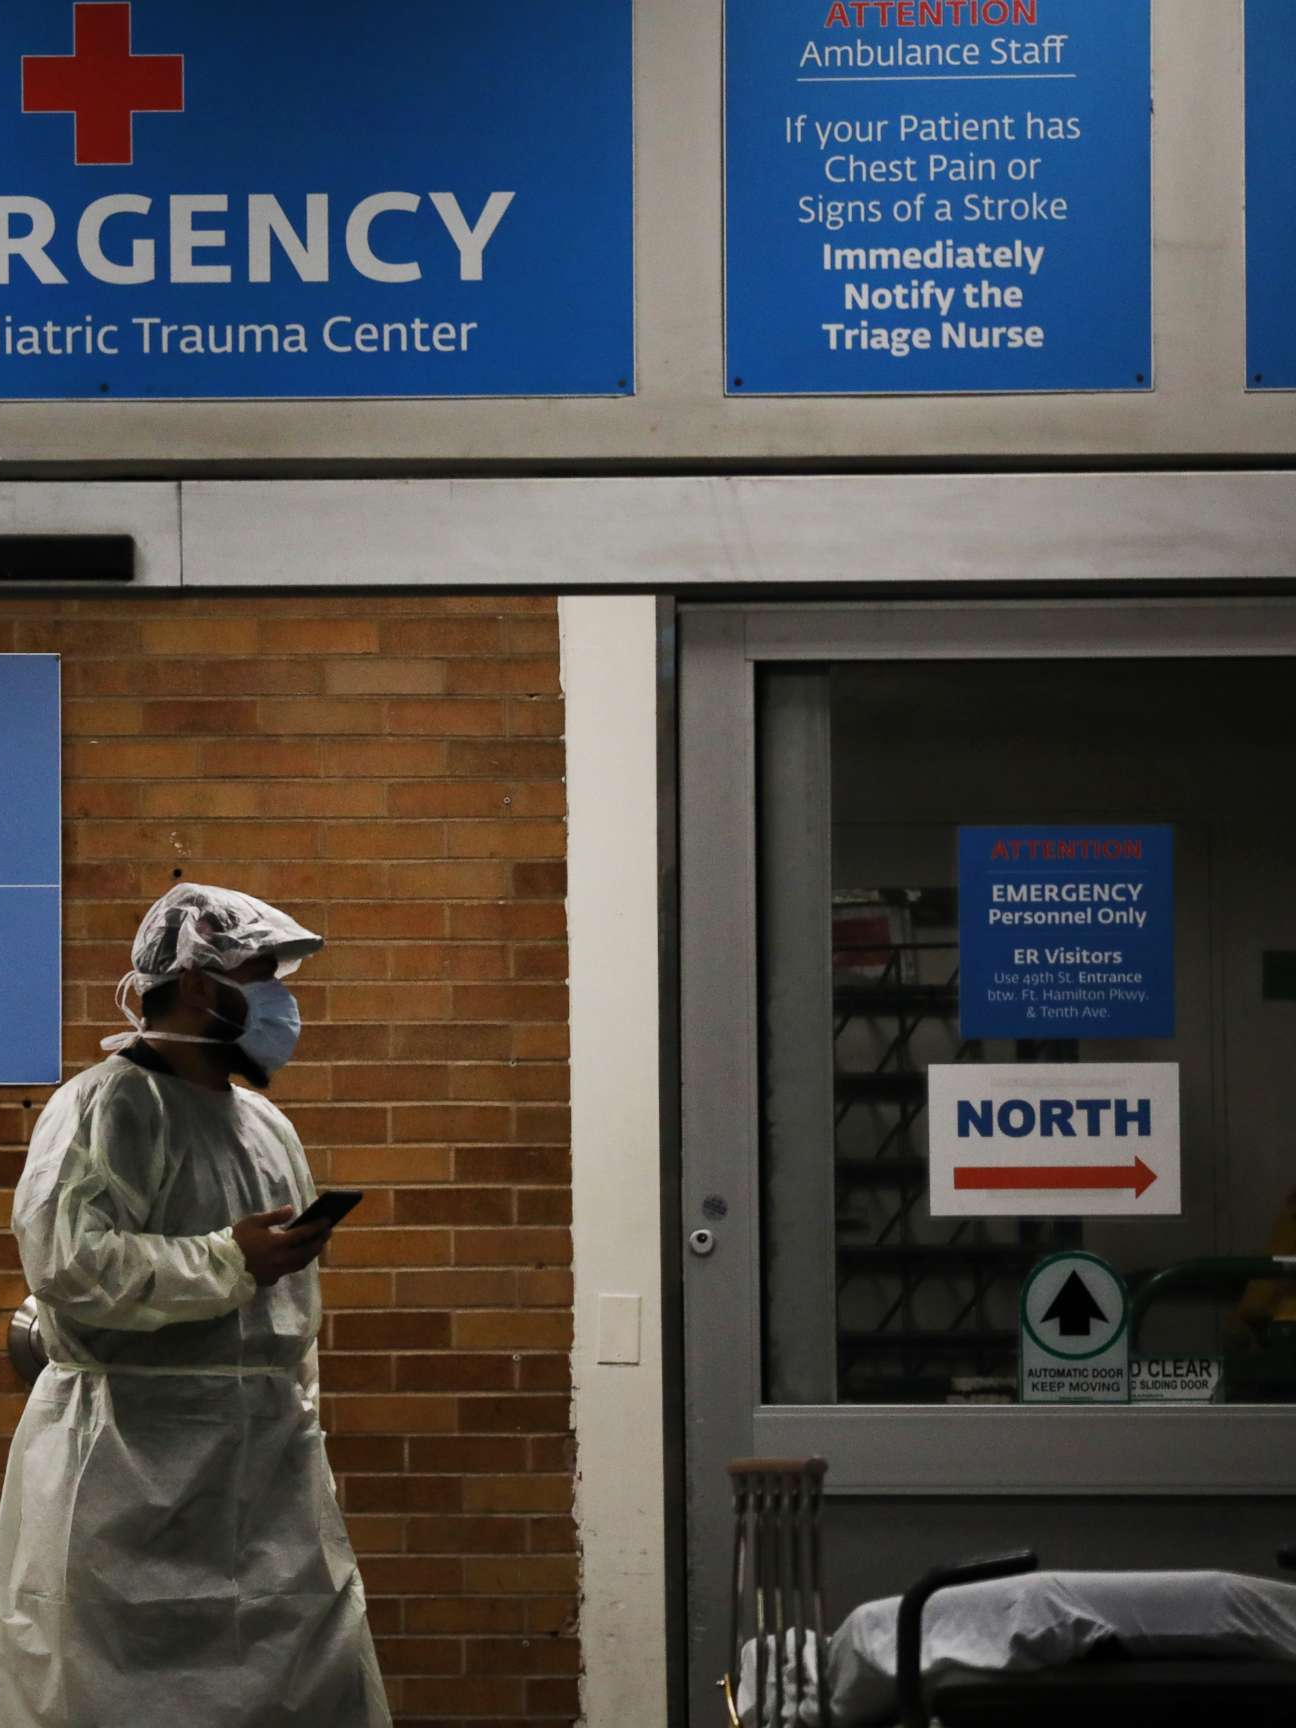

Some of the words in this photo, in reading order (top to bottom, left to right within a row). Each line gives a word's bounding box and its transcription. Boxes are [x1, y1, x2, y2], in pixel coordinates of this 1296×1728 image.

[824, 0, 1037, 28] ATTENTION
[800, 38, 980, 67] Ambulance
[990, 35, 1068, 64] Staff
[786, 115, 807, 143] If
[815, 120, 888, 150] your
[900, 112, 1016, 141] Patient
[1027, 112, 1081, 140] has
[825, 155, 917, 183] Chest
[929, 152, 996, 181] Pain
[1007, 157, 1041, 180] or
[799, 194, 882, 230] Signs
[893, 193, 926, 222] of
[934, 198, 952, 221] a
[964, 192, 1068, 221] Stroke
[823, 239, 1044, 274] Immediately
[844, 280, 955, 316] Notify
[963, 280, 1023, 308] the
[133, 317, 308, 354] Trauma
[322, 316, 478, 353] Center
[822, 320, 931, 357] Triage
[941, 322, 1044, 349] Nurse
[992, 839, 1143, 860] ATTENTION
[992, 884, 1143, 902] EMERGENCY
[988, 907, 1092, 925] Personnel
[1098, 907, 1147, 928] Only
[1014, 949, 1040, 964] ER
[1045, 947, 1122, 964] Visitors
[994, 971, 1019, 983] Use
[1023, 971, 1054, 986] 49th
[1078, 971, 1142, 983] Entrance
[1043, 988, 1105, 1000] Hamilton
[1110, 989, 1149, 1002] Pkwy.
[1027, 1006, 1036, 1018] &
[1040, 1006, 1078, 1018] Tenth
[1082, 1006, 1111, 1018] Ave.
[957, 1099, 1151, 1138] NORTH
[1028, 1367, 1088, 1378] AUTOMATIC
[1092, 1367, 1124, 1378] DOOR
[1148, 1360, 1212, 1378] CLEAR
[1032, 1381, 1065, 1392] KEEP
[1069, 1381, 1121, 1392] MOVING
[1140, 1380, 1179, 1390] SLIDING
[1181, 1380, 1209, 1390] DOOR
